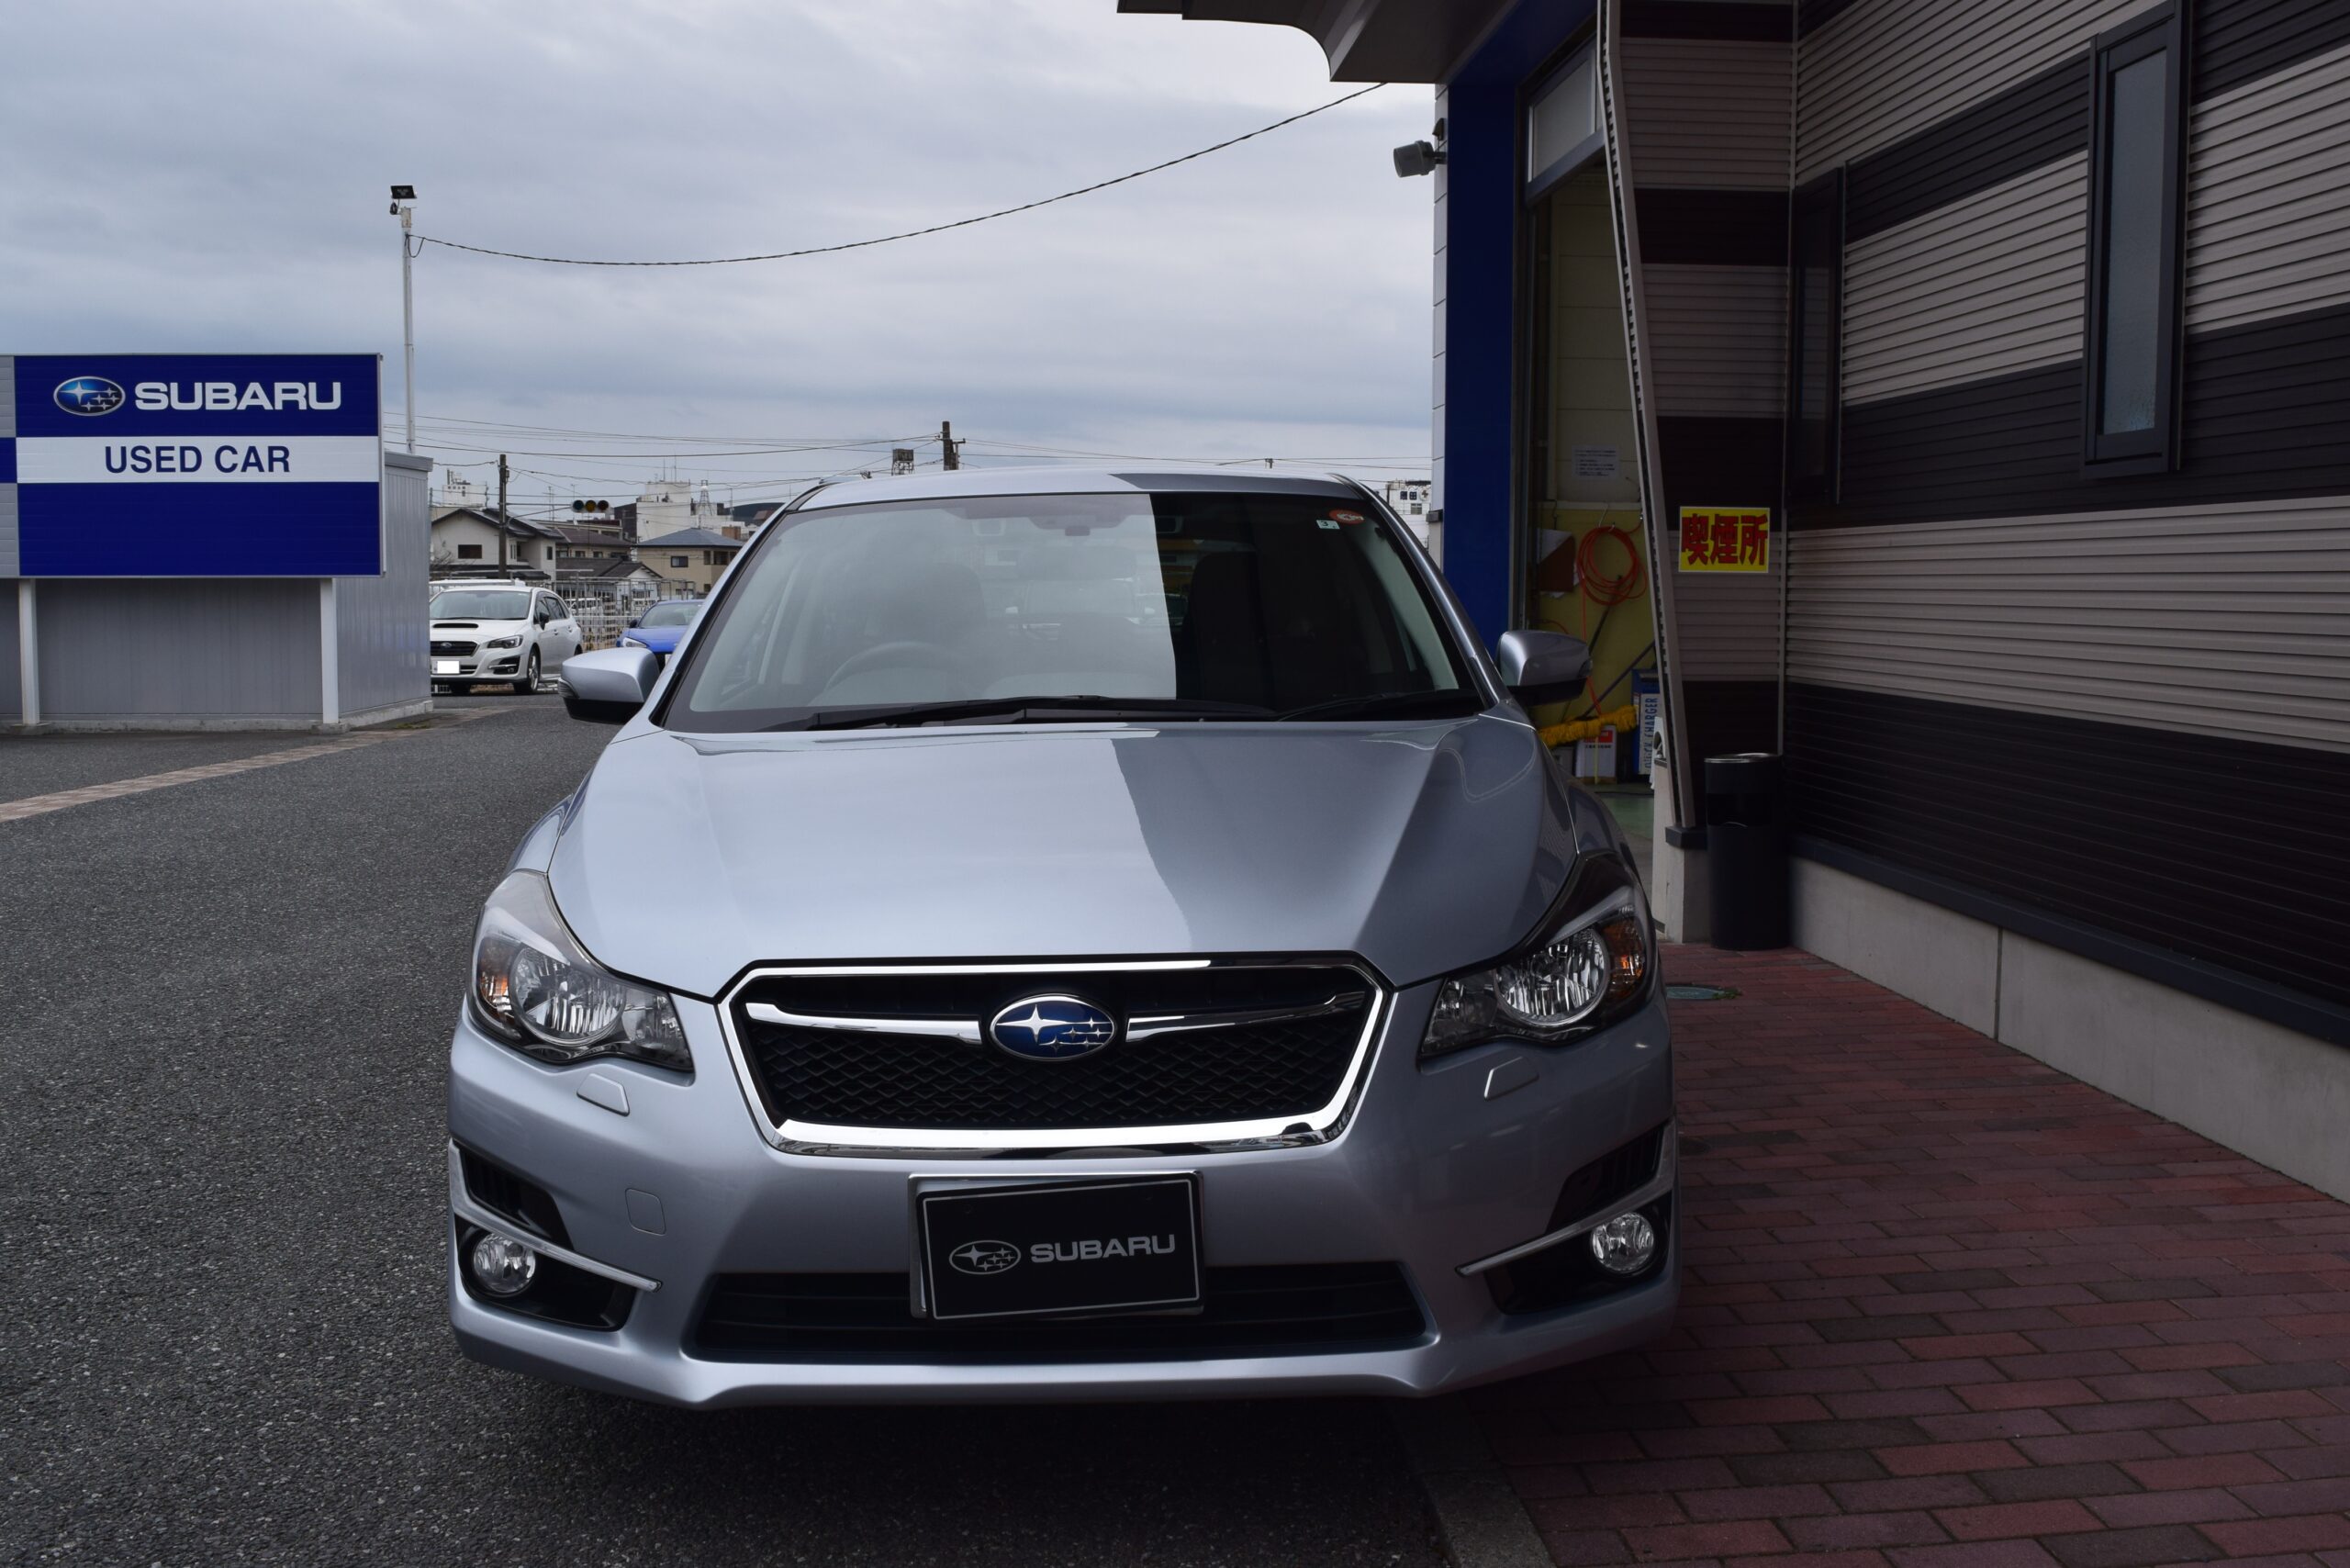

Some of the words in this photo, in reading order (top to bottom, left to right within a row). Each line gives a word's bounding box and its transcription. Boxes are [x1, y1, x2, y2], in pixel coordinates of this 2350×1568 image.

[135, 381, 342, 410] SUBARU
[105, 445, 203, 474] USED
[214, 445, 290, 473] CAR
[1681, 512, 1768, 566] 喫煙所
[1030, 1234, 1176, 1264] SUBARU
